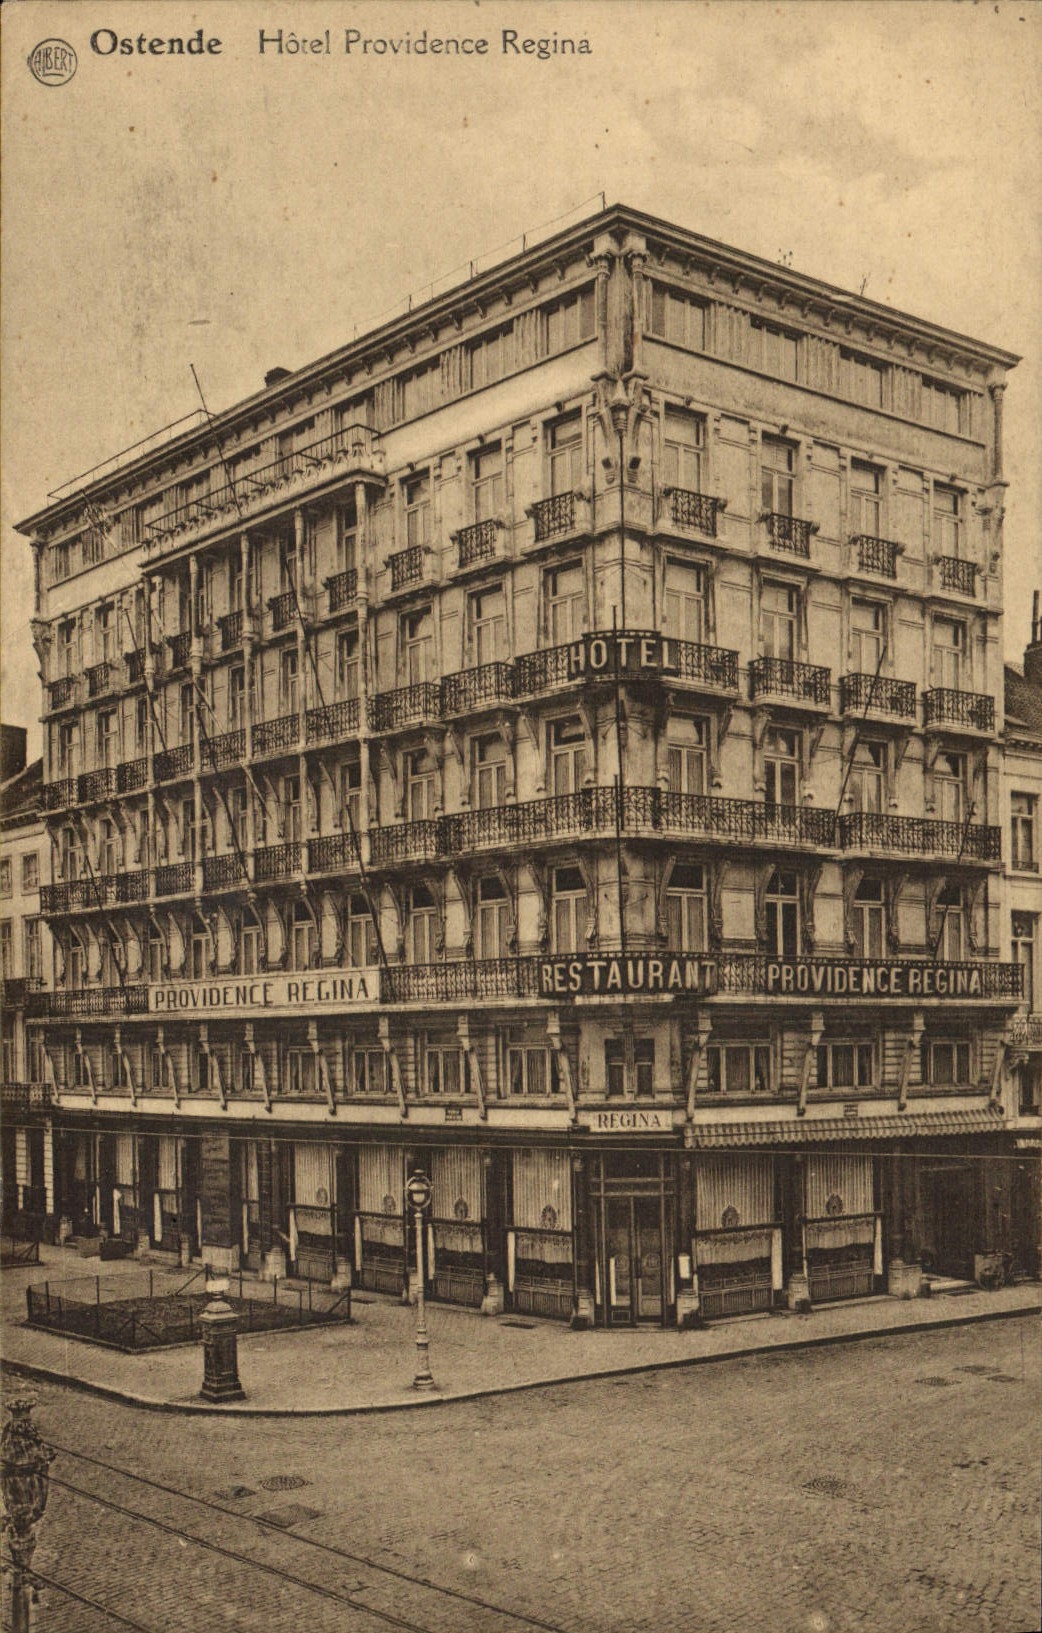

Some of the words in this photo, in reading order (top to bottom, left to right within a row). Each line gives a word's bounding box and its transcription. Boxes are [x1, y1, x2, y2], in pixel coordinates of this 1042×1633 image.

[569, 638, 677, 674] HOTEL
[154, 981, 275, 1009] PROVIDENCE
[287, 976, 370, 1003] REGINA
[541, 959, 717, 994] RESTAURANT
[767, 963, 903, 994] PROVIDENCE
[908, 967, 983, 995] REGINA
[597, 1112, 663, 1130] REGINA
